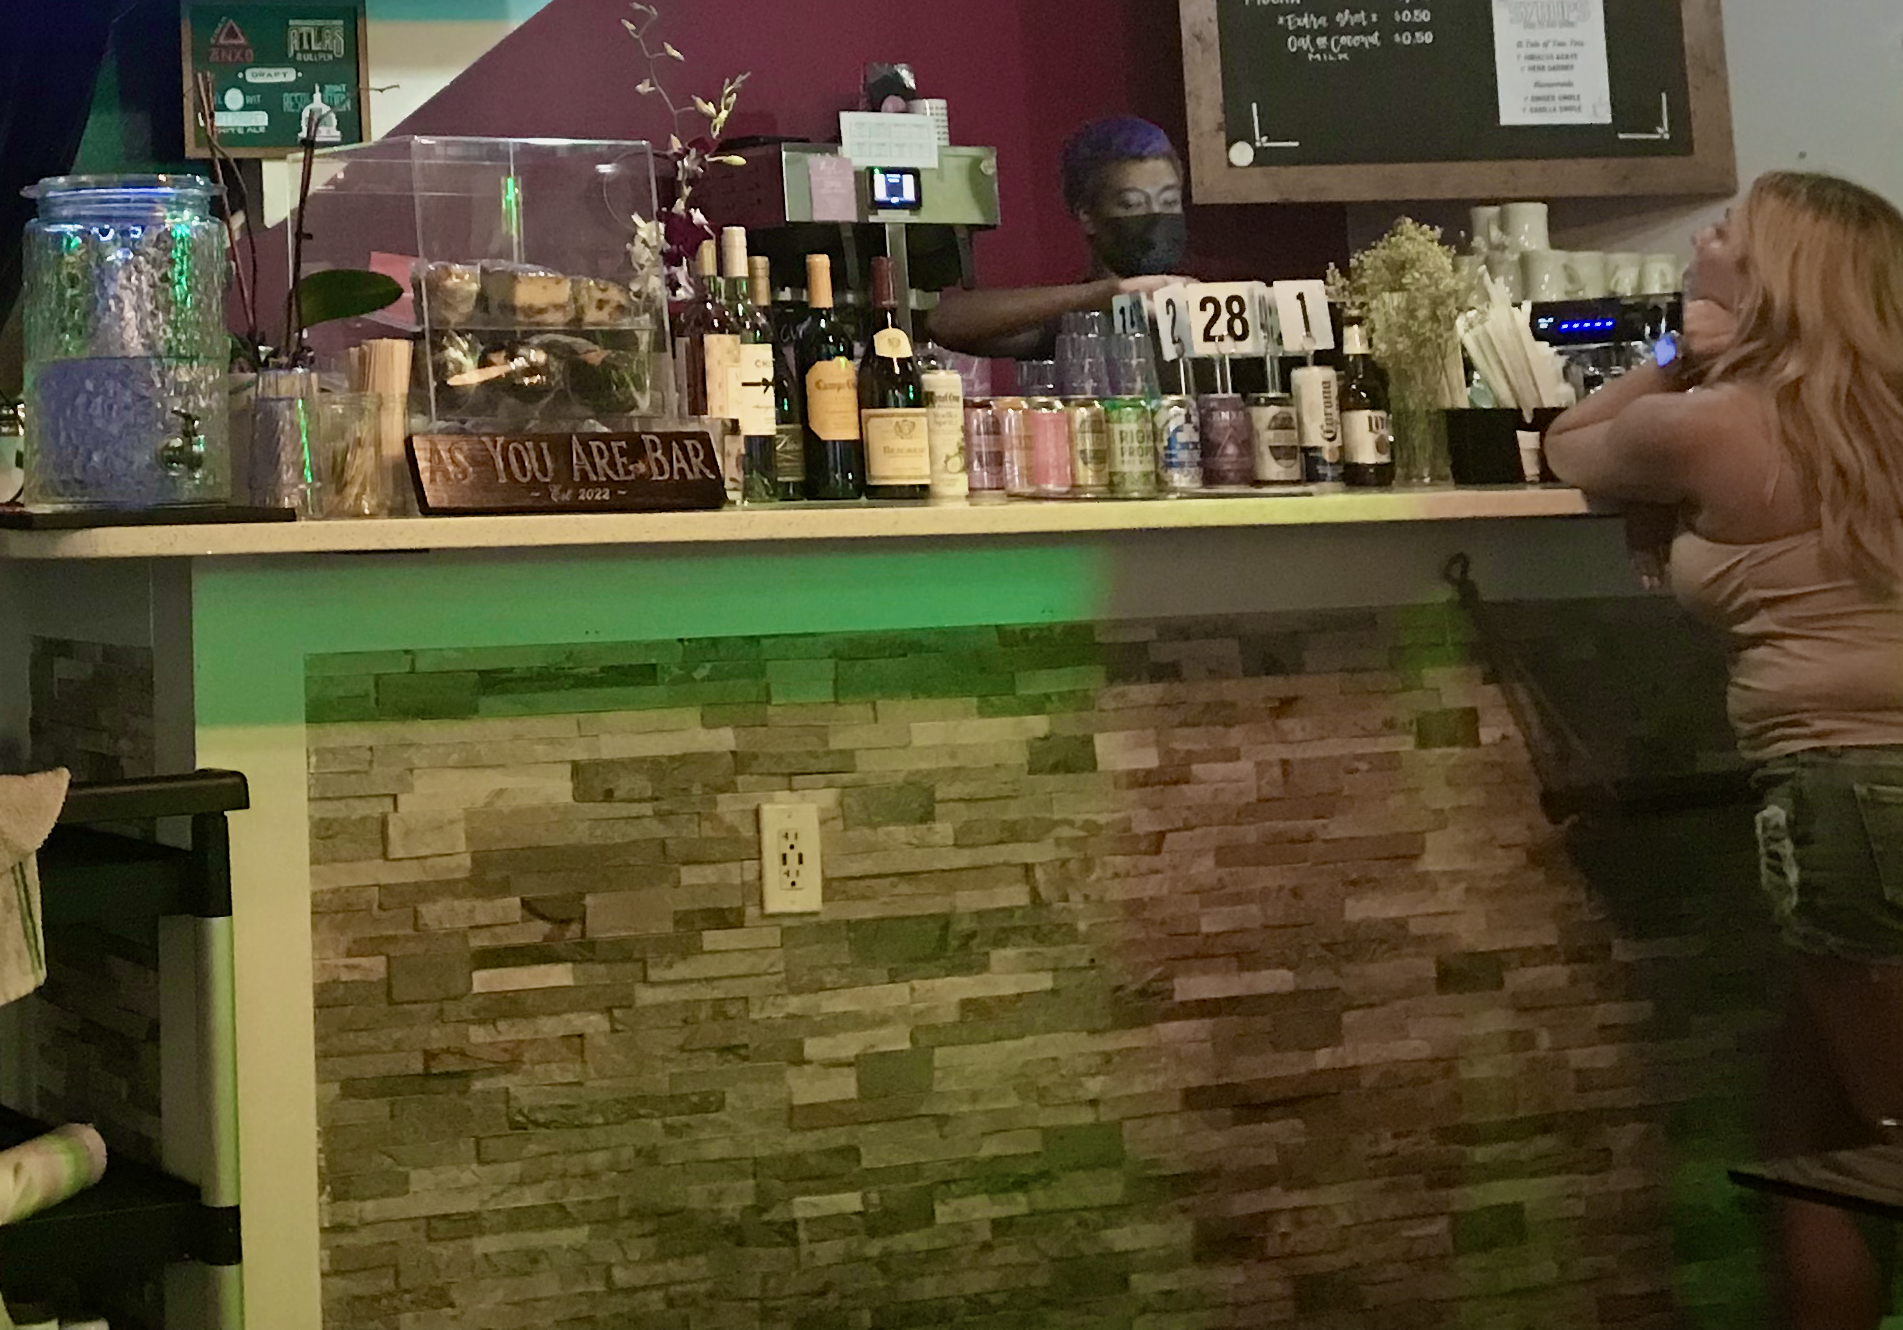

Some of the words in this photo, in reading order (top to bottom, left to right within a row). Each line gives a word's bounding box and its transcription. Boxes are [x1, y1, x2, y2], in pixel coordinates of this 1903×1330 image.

[1394, 9, 1432, 23] $0.50
[287, 25, 345, 59] ATLAS
[1393, 31, 1434, 45] $0.50
[1307, 52, 1350, 62] MILK
[250, 71, 289, 79] DRAFT
[1198, 294, 1250, 343] 28
[1296, 291, 1312, 336] 1
[1320, 380, 1338, 443] Corona
[480, 435, 553, 484] YOU
[571, 433, 636, 483] ARE
[641, 433, 717, 482] BAR
[577, 486, 611, 501] 2022
